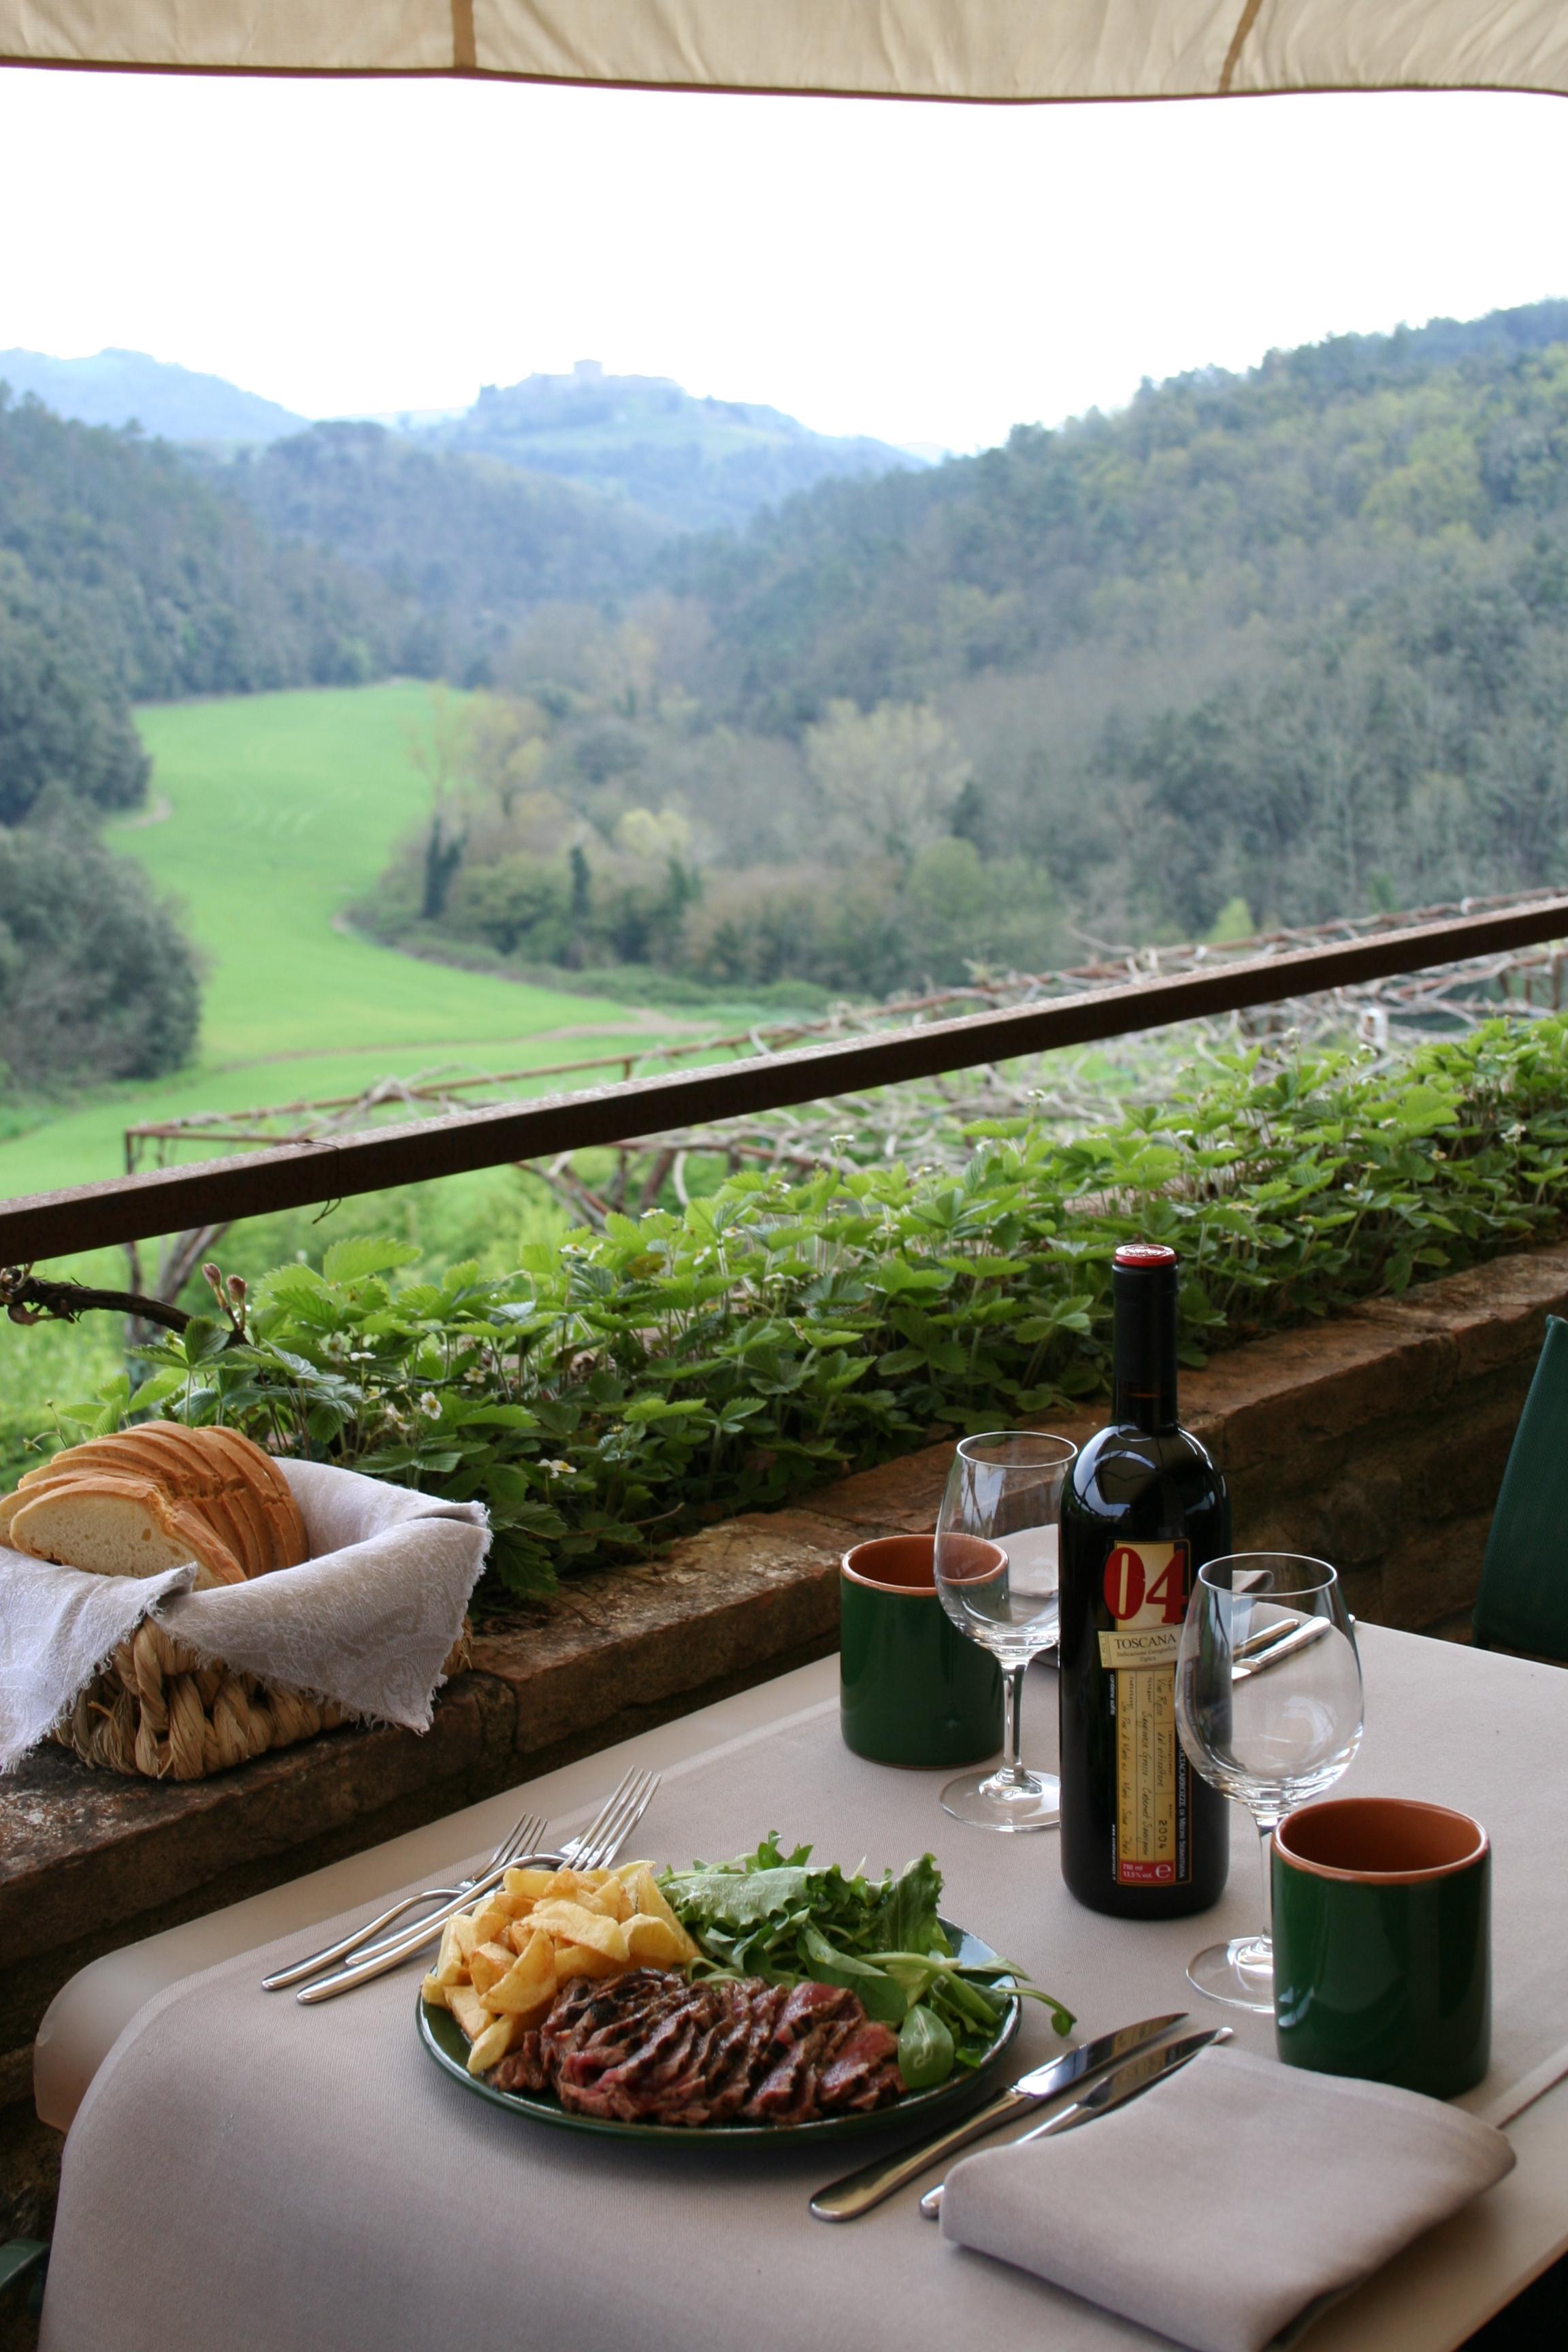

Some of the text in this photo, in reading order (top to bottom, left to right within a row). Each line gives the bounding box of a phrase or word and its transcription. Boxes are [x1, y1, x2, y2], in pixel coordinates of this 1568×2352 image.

[1104, 1547, 1190, 1624] 04
[1114, 1633, 1177, 1649] TOSCANA
[1148, 1646, 1177, 1655] Geografica
[1158, 1820, 1167, 1849] 2004
